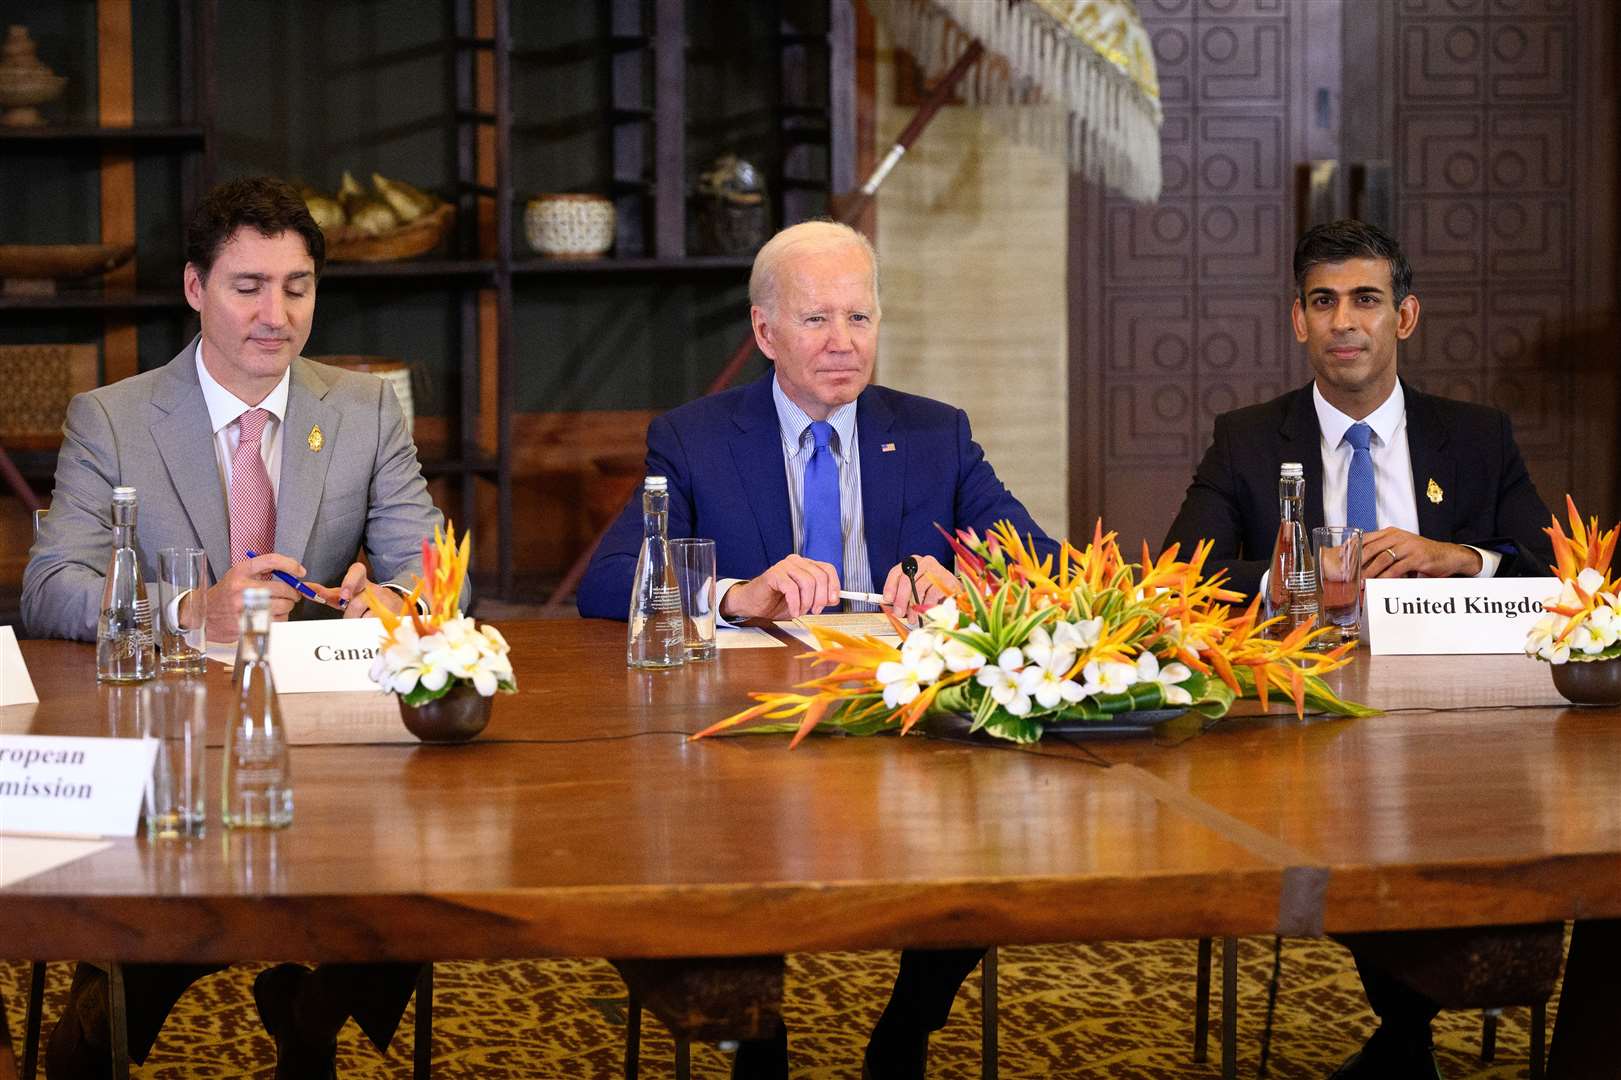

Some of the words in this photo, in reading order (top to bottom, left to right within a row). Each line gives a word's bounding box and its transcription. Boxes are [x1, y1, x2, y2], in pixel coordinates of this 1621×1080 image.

[1384, 597, 1456, 614] United
[1464, 596, 1551, 618] Kingdo
[314, 645, 380, 661] Cana
[0, 748, 85, 768] ropean
[0, 776, 92, 798] mission
